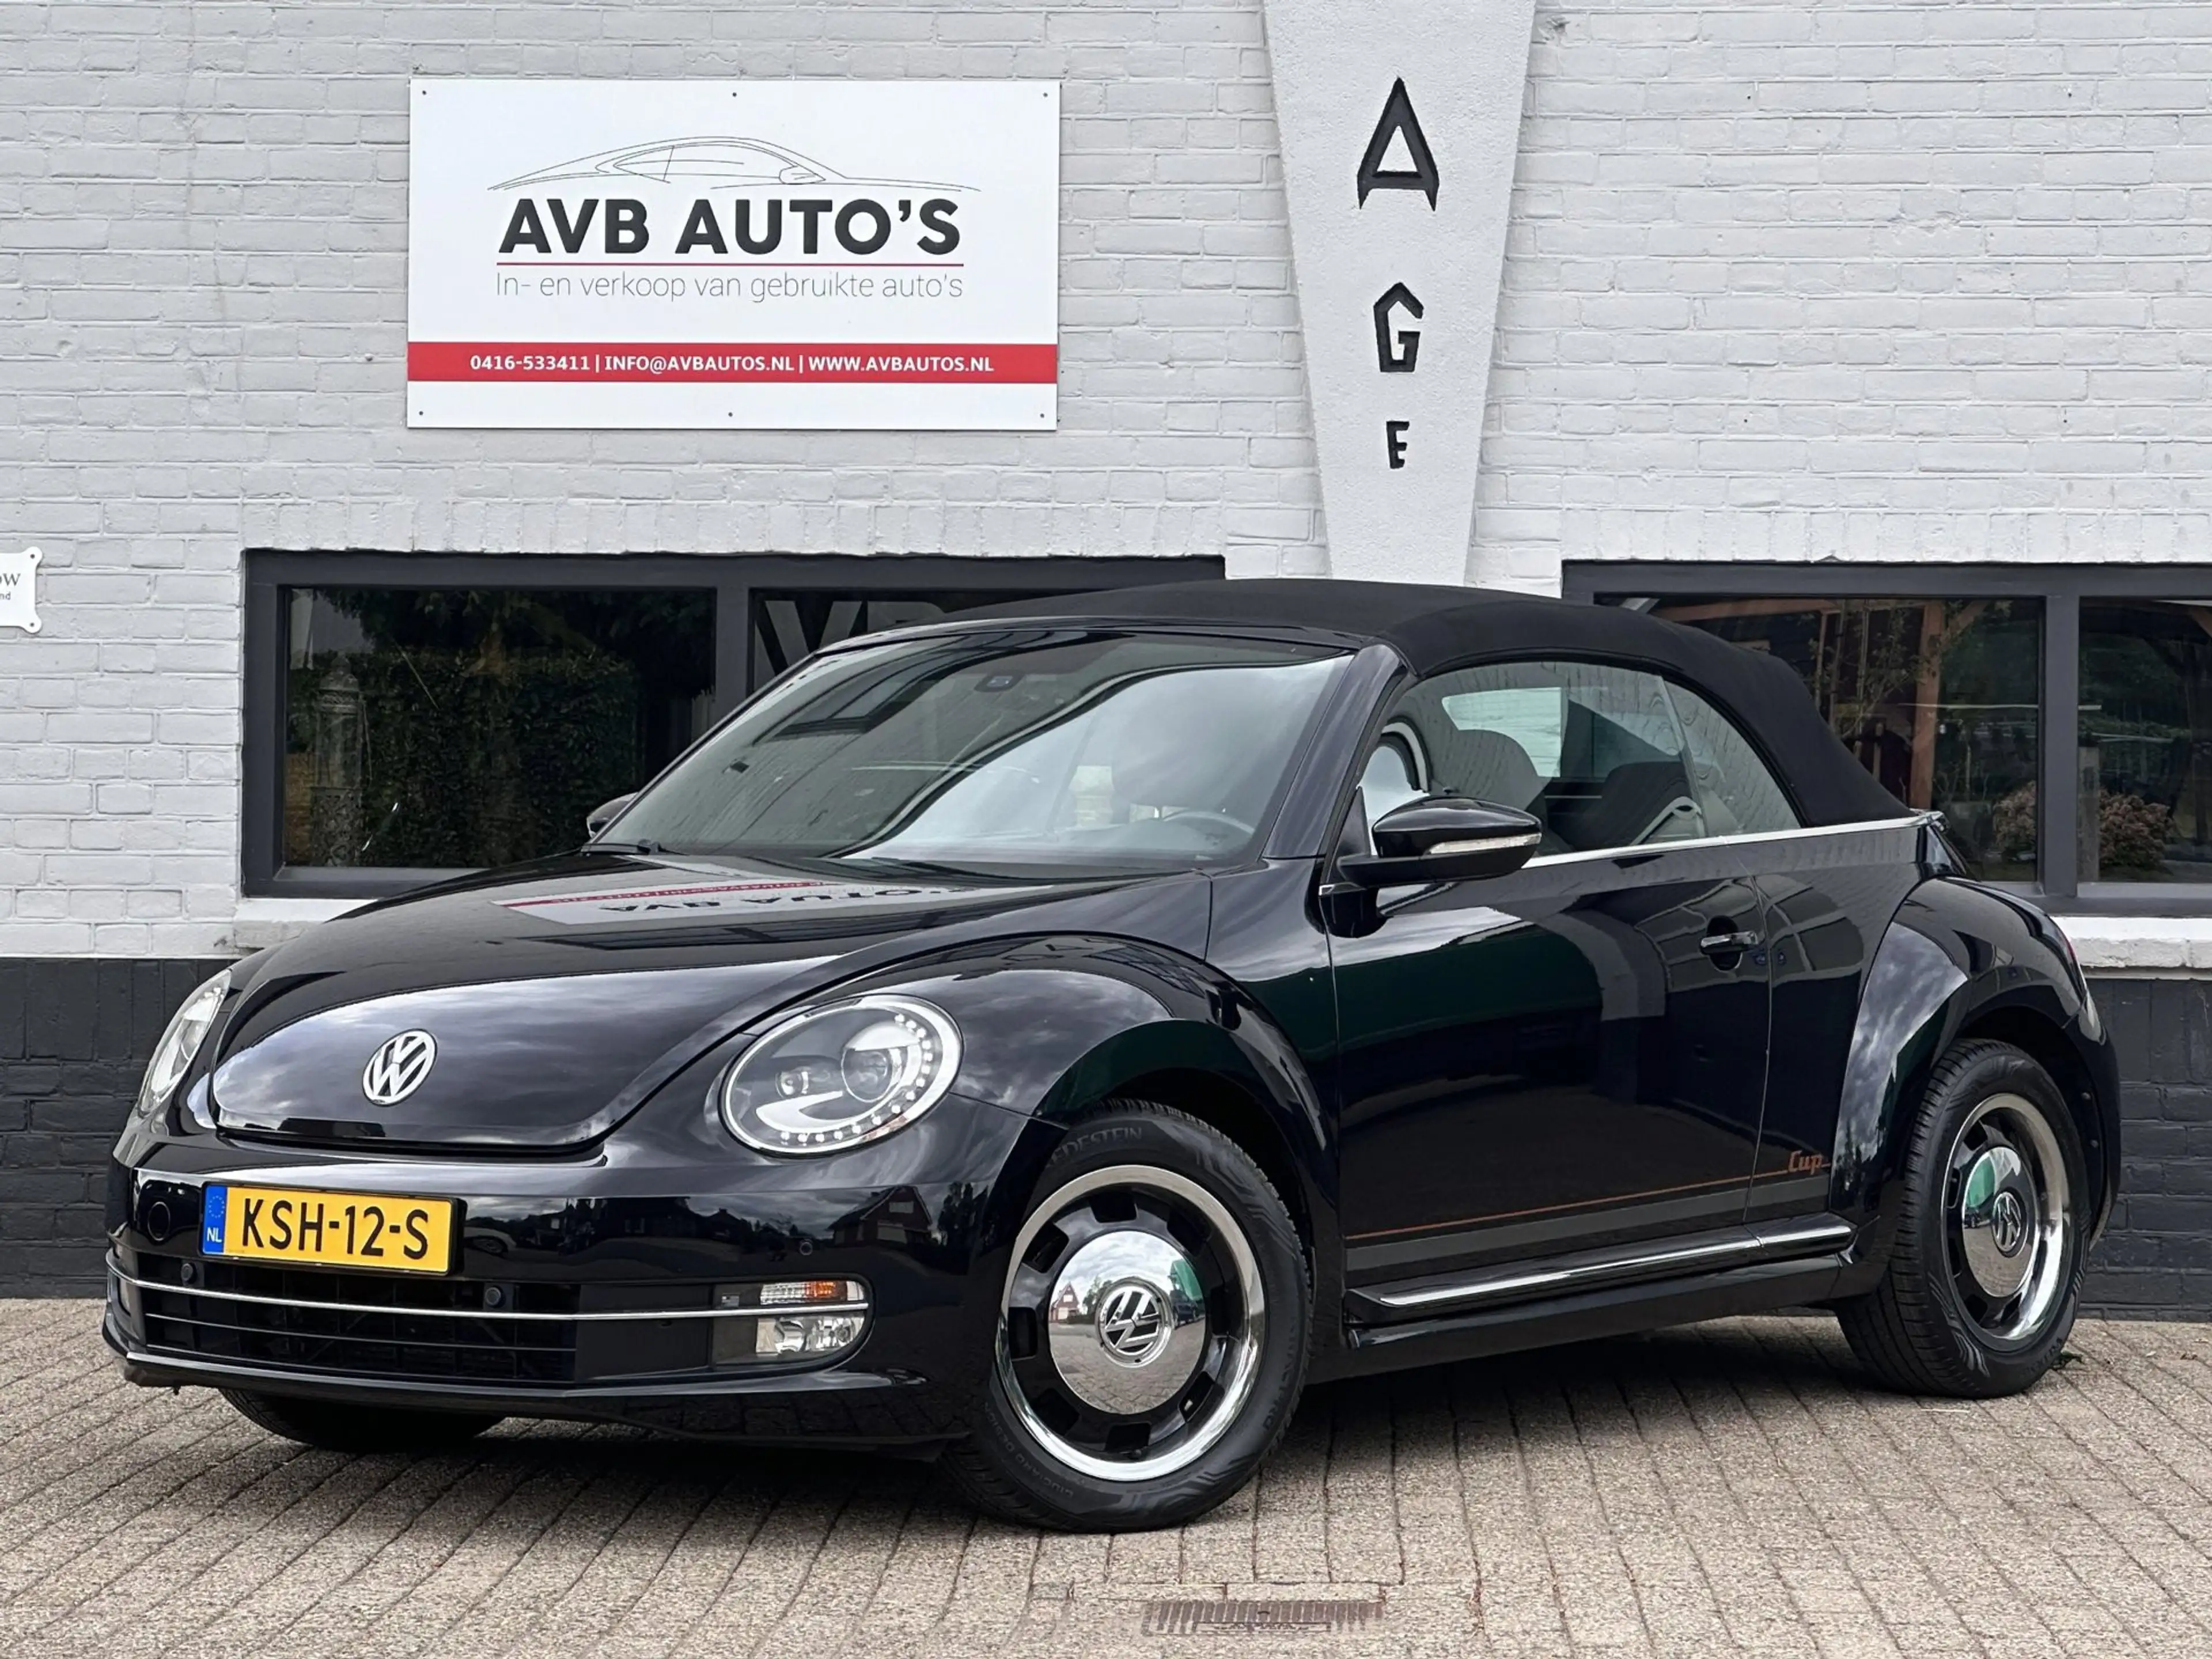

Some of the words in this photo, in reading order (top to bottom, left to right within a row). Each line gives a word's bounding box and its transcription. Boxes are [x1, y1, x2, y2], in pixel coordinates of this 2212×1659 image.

[498, 198, 650, 254] AVB
[675, 198, 961, 255] AUTO'S
[497, 272, 531, 296] In-
[540, 277, 571, 296] en
[579, 272, 685, 302] verkoop
[694, 277, 741, 297] van
[751, 271, 874, 303] gebruikte
[882, 273, 963, 298] auto's
[469, 354, 591, 372] 0416-533411
[604, 355, 795, 374] INFO@AVBAUTOS.NL
[808, 355, 994, 373] WWW.AVBAUTOS.NL
[1787, 1150, 1823, 1176] Cup
[206, 1226, 222, 1243] NL
[242, 1198, 429, 1260] KSH-12-S
